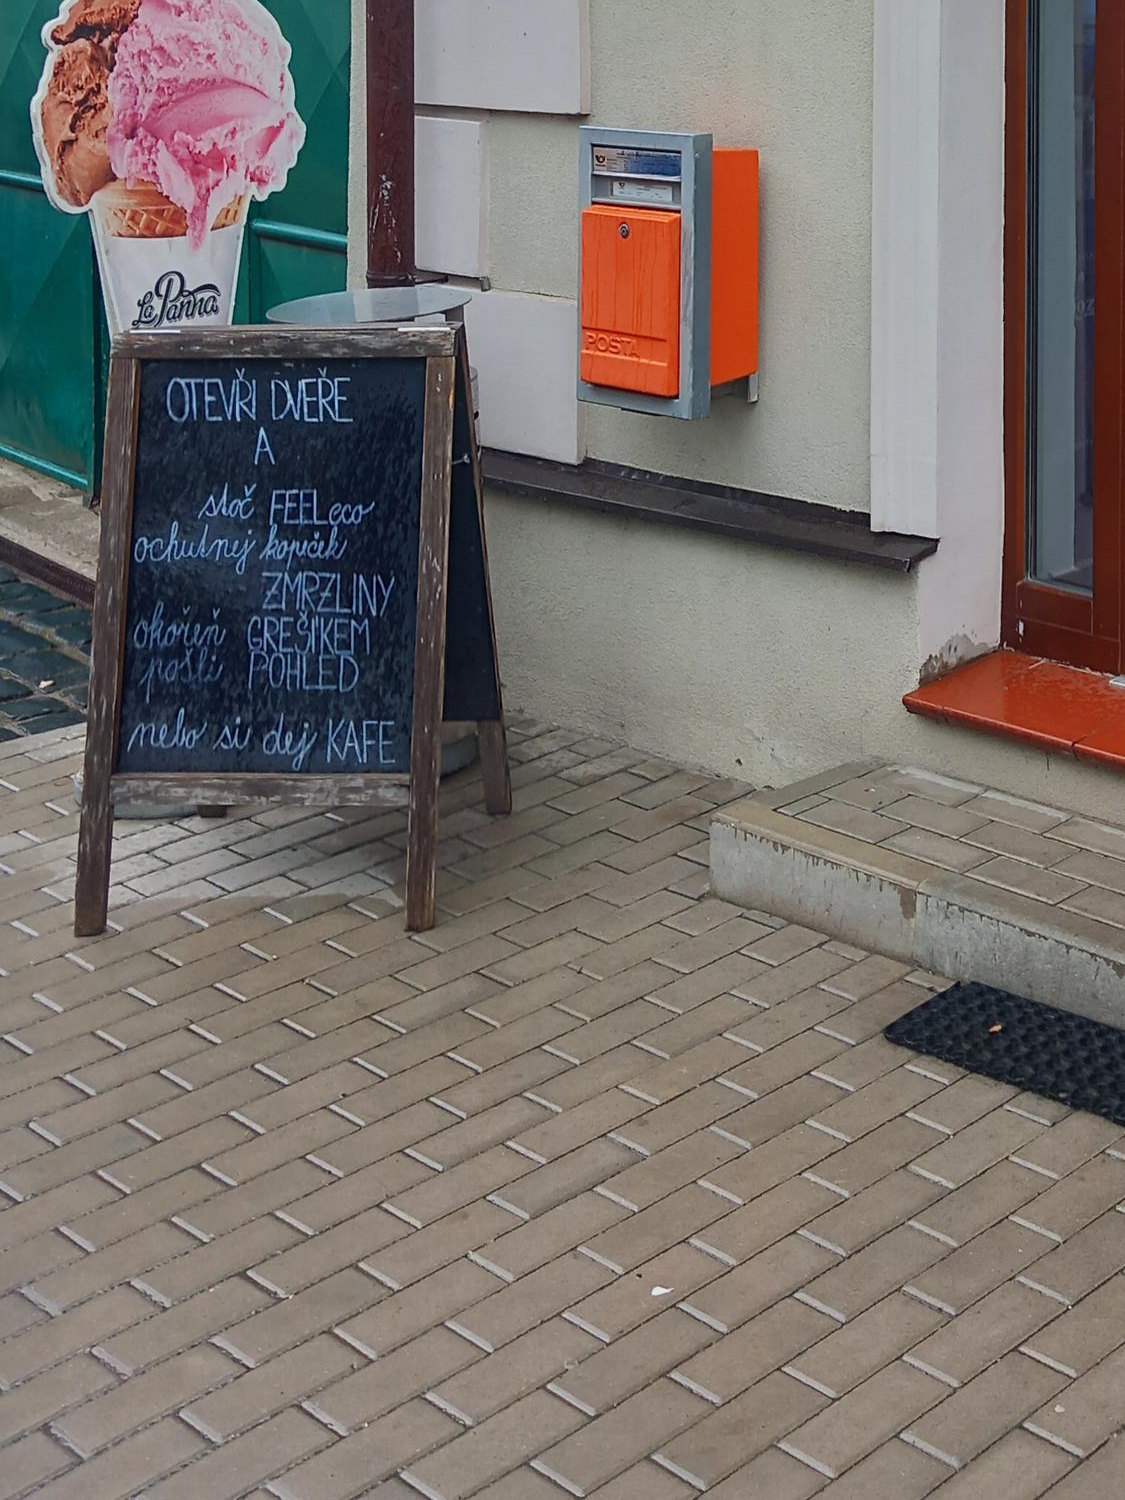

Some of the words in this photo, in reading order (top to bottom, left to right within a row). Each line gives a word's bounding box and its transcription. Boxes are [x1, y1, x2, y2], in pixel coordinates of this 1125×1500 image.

[132, 291, 157, 328] La
[154, 271, 221, 327] Panna
[166, 367, 256, 422] OTEVŘI
[271, 366, 353, 422] DVEŘE
[254, 426, 276, 465] A
[134, 521, 256, 574] ochutnej
[262, 571, 395, 616] ZMRZLINY
[248, 651, 359, 692] POHLED
[127, 707, 207, 753] nebo
[212, 716, 251, 750] si
[263, 713, 318, 770] dej
[326, 718, 396, 764] KAFE
